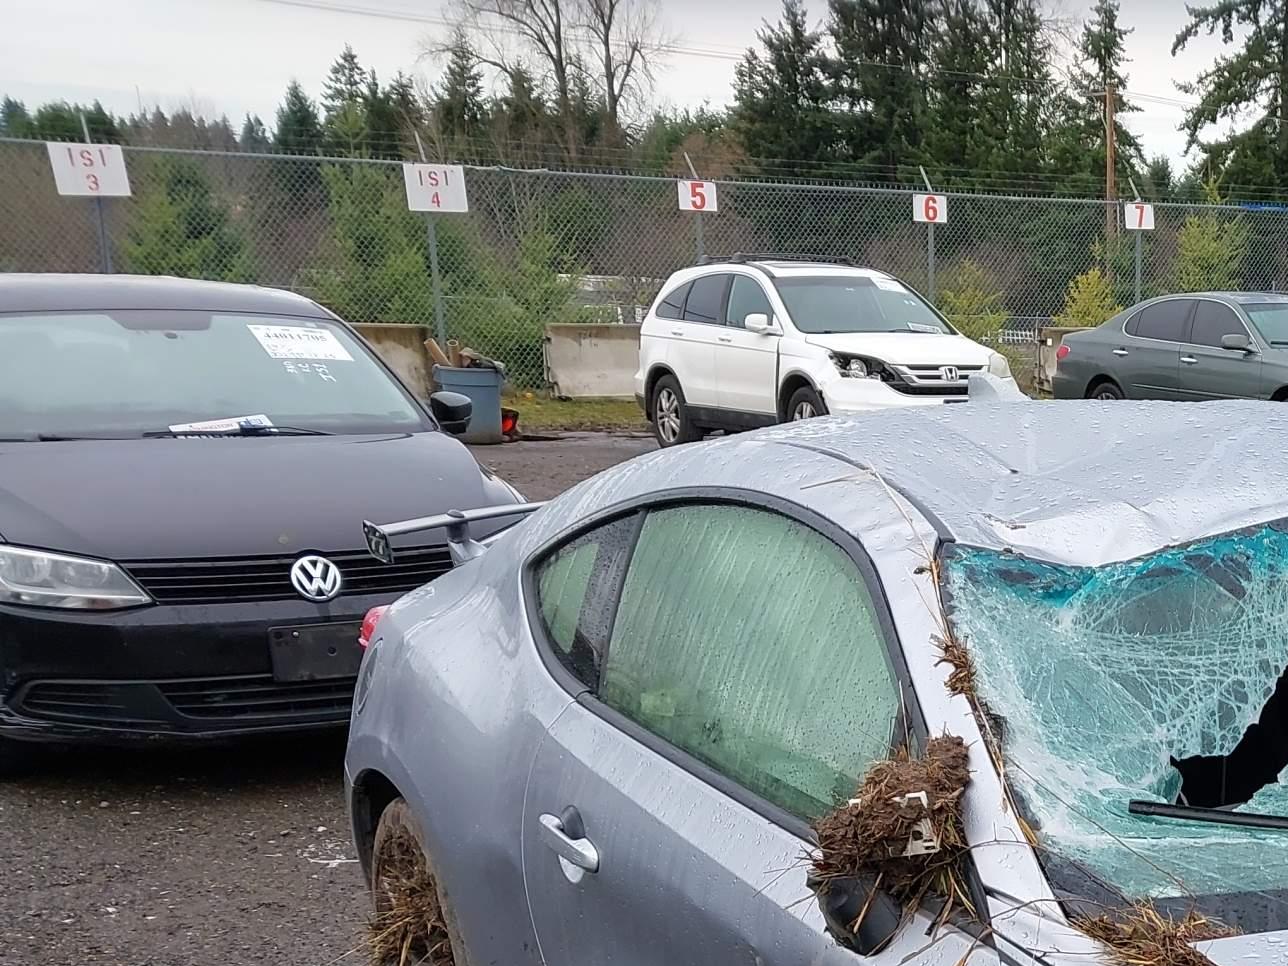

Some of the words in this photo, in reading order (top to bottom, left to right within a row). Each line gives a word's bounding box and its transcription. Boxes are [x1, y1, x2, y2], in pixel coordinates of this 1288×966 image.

[86, 173, 99, 191] 3
[431, 191, 441, 208] 4
[690, 182, 706, 210] 5
[924, 195, 938, 221] 6
[1135, 205, 1145, 228] 7
